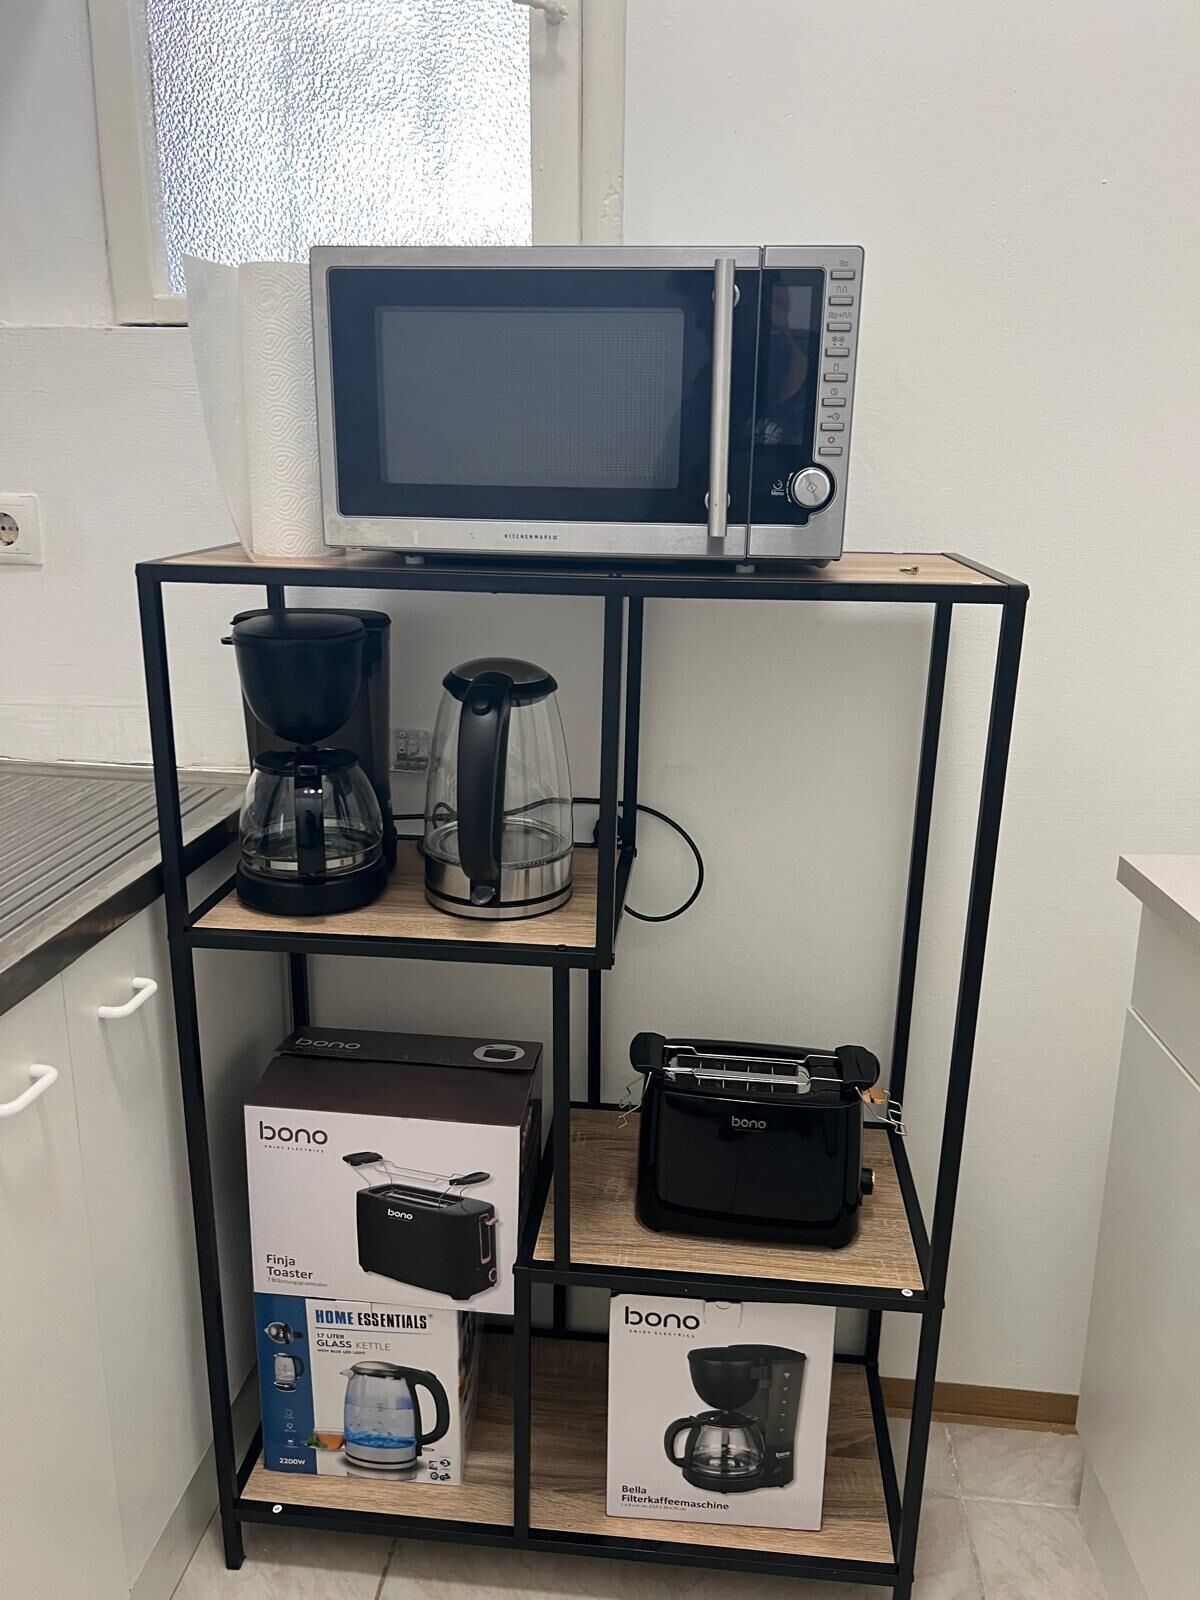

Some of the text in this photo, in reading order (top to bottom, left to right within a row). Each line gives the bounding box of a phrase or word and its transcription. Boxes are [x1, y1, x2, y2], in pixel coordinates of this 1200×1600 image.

[296, 1037, 361, 1049] bono
[731, 1115, 767, 1129] bono
[259, 1120, 328, 1145] bono
[387, 1208, 413, 1220] bono
[266, 1254, 296, 1268] Finja
[266, 1266, 314, 1280] Toaster
[315, 1309, 427, 1329] HOME ESSENTIALS
[624, 1305, 700, 1330] bono
[316, 1340, 391, 1351] GLASS KETTLE
[279, 1457, 306, 1466] 2200W
[621, 1485, 648, 1495] Bella
[621, 1494, 730, 1511] Filterkaffeemaschine
